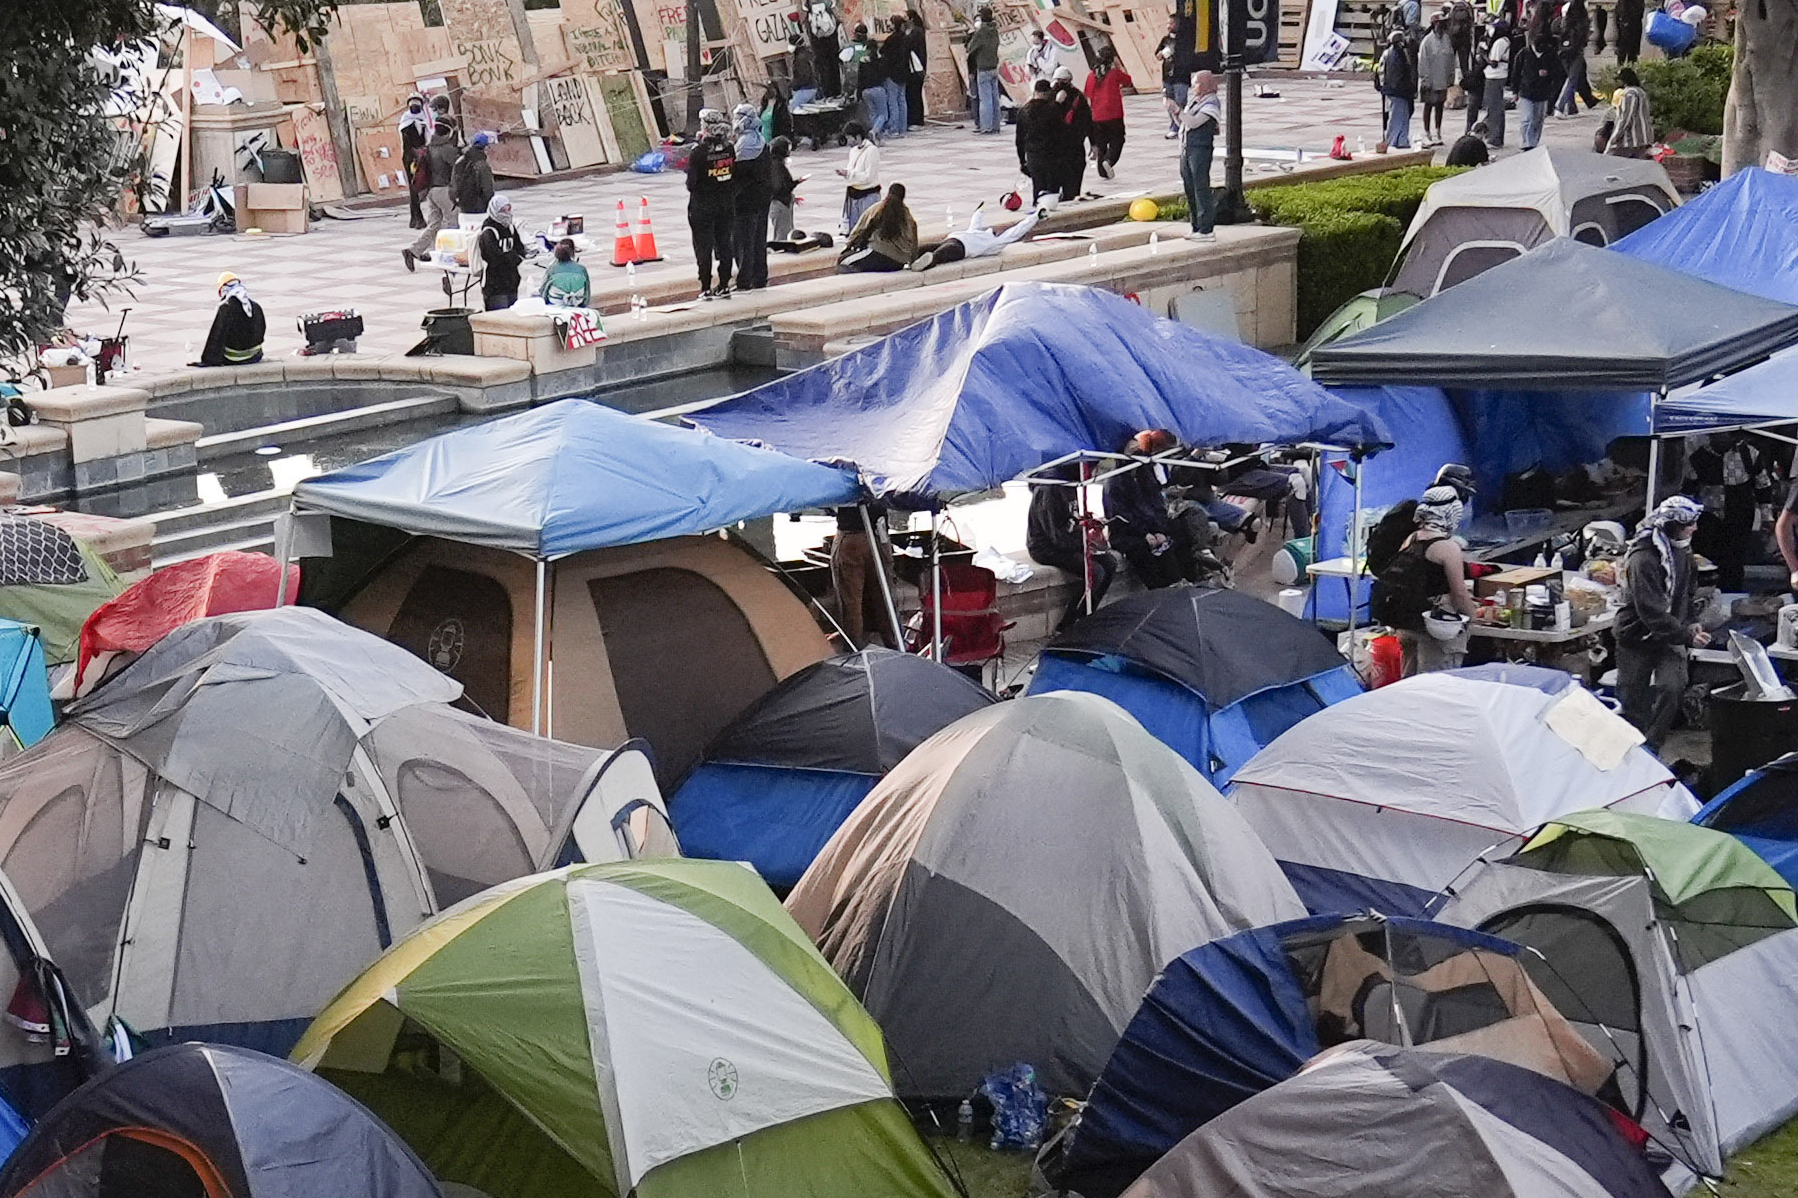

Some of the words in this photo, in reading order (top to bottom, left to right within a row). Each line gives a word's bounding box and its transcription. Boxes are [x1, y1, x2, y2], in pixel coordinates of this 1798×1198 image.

[754, 11, 792, 43] GAZA
[467, 61, 514, 86] BONK
[554, 101, 592, 127] BACK
